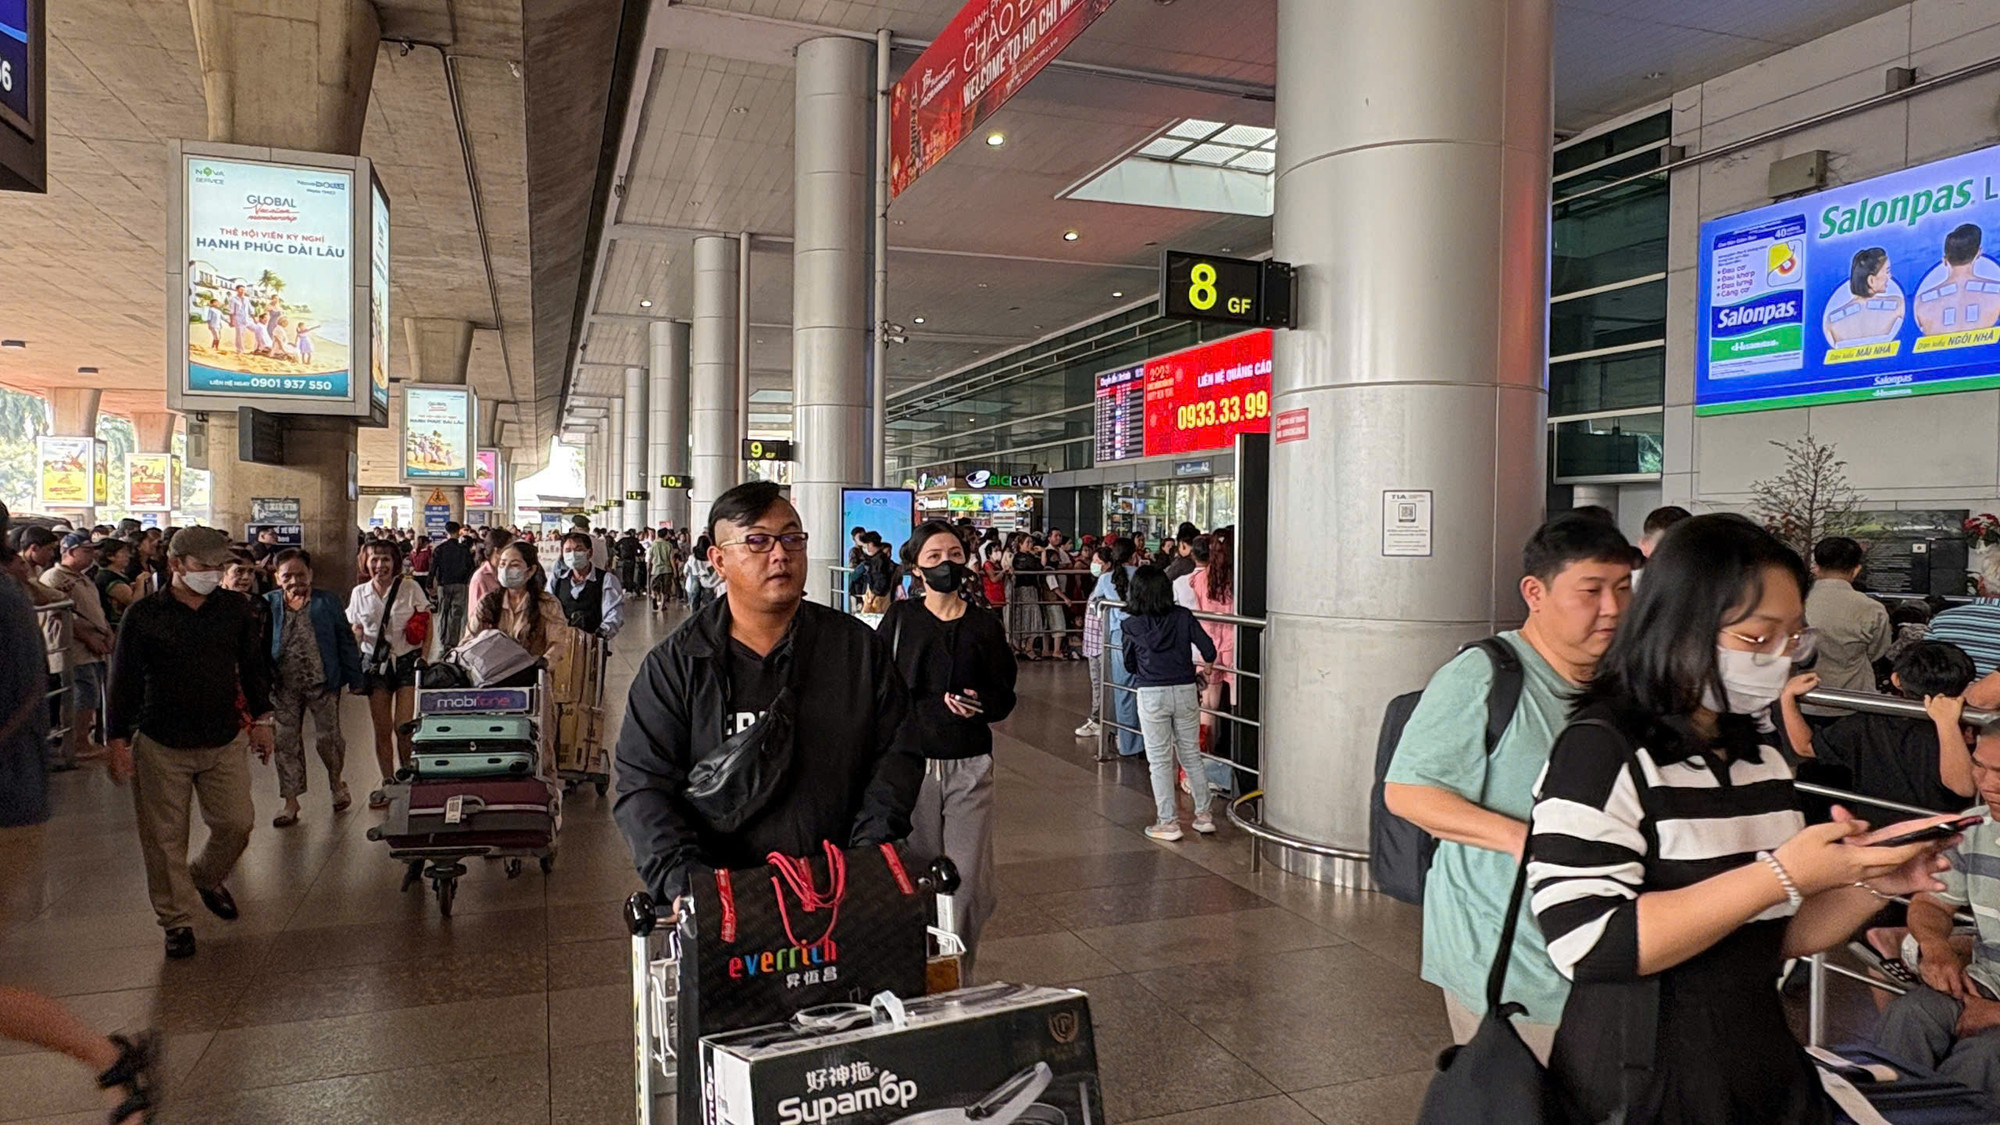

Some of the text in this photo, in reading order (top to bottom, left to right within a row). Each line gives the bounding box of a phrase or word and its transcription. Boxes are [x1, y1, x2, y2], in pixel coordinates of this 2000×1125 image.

[962, 3, 1014, 73] CHÀO
[962, 46, 1006, 108] WELCOME
[1008, 33, 1021, 65] TO
[1022, 17, 1037, 52] HO
[1039, 0, 1057, 35] CHI
[246, 194, 297, 209] GLOBAL
[1819, 179, 1974, 239] Salonpas
[1775, 228, 1787, 239] 40
[196, 237, 345, 258] HẠNH PHÚC DÀI LÂU
[1189, 263, 1251, 314] 8 GF
[1717, 300, 1796, 329] Salonpas
[250, 377, 280, 388] 0901
[284, 379, 306, 389] 937
[308, 380, 332, 390] 550
[1197, 373, 1214, 388] LIÊN
[1214, 370, 1225, 386] HỆ
[1873, 374, 1913, 386] Salonpas
[751, 442, 762, 458] 9
[662, 477, 675, 487] 10
[436, 695, 510, 708] mobifone
[728, 938, 838, 979] everrich
[805, 1060, 875, 1094] 好神拖
[777, 1077, 918, 1125] Supamop
